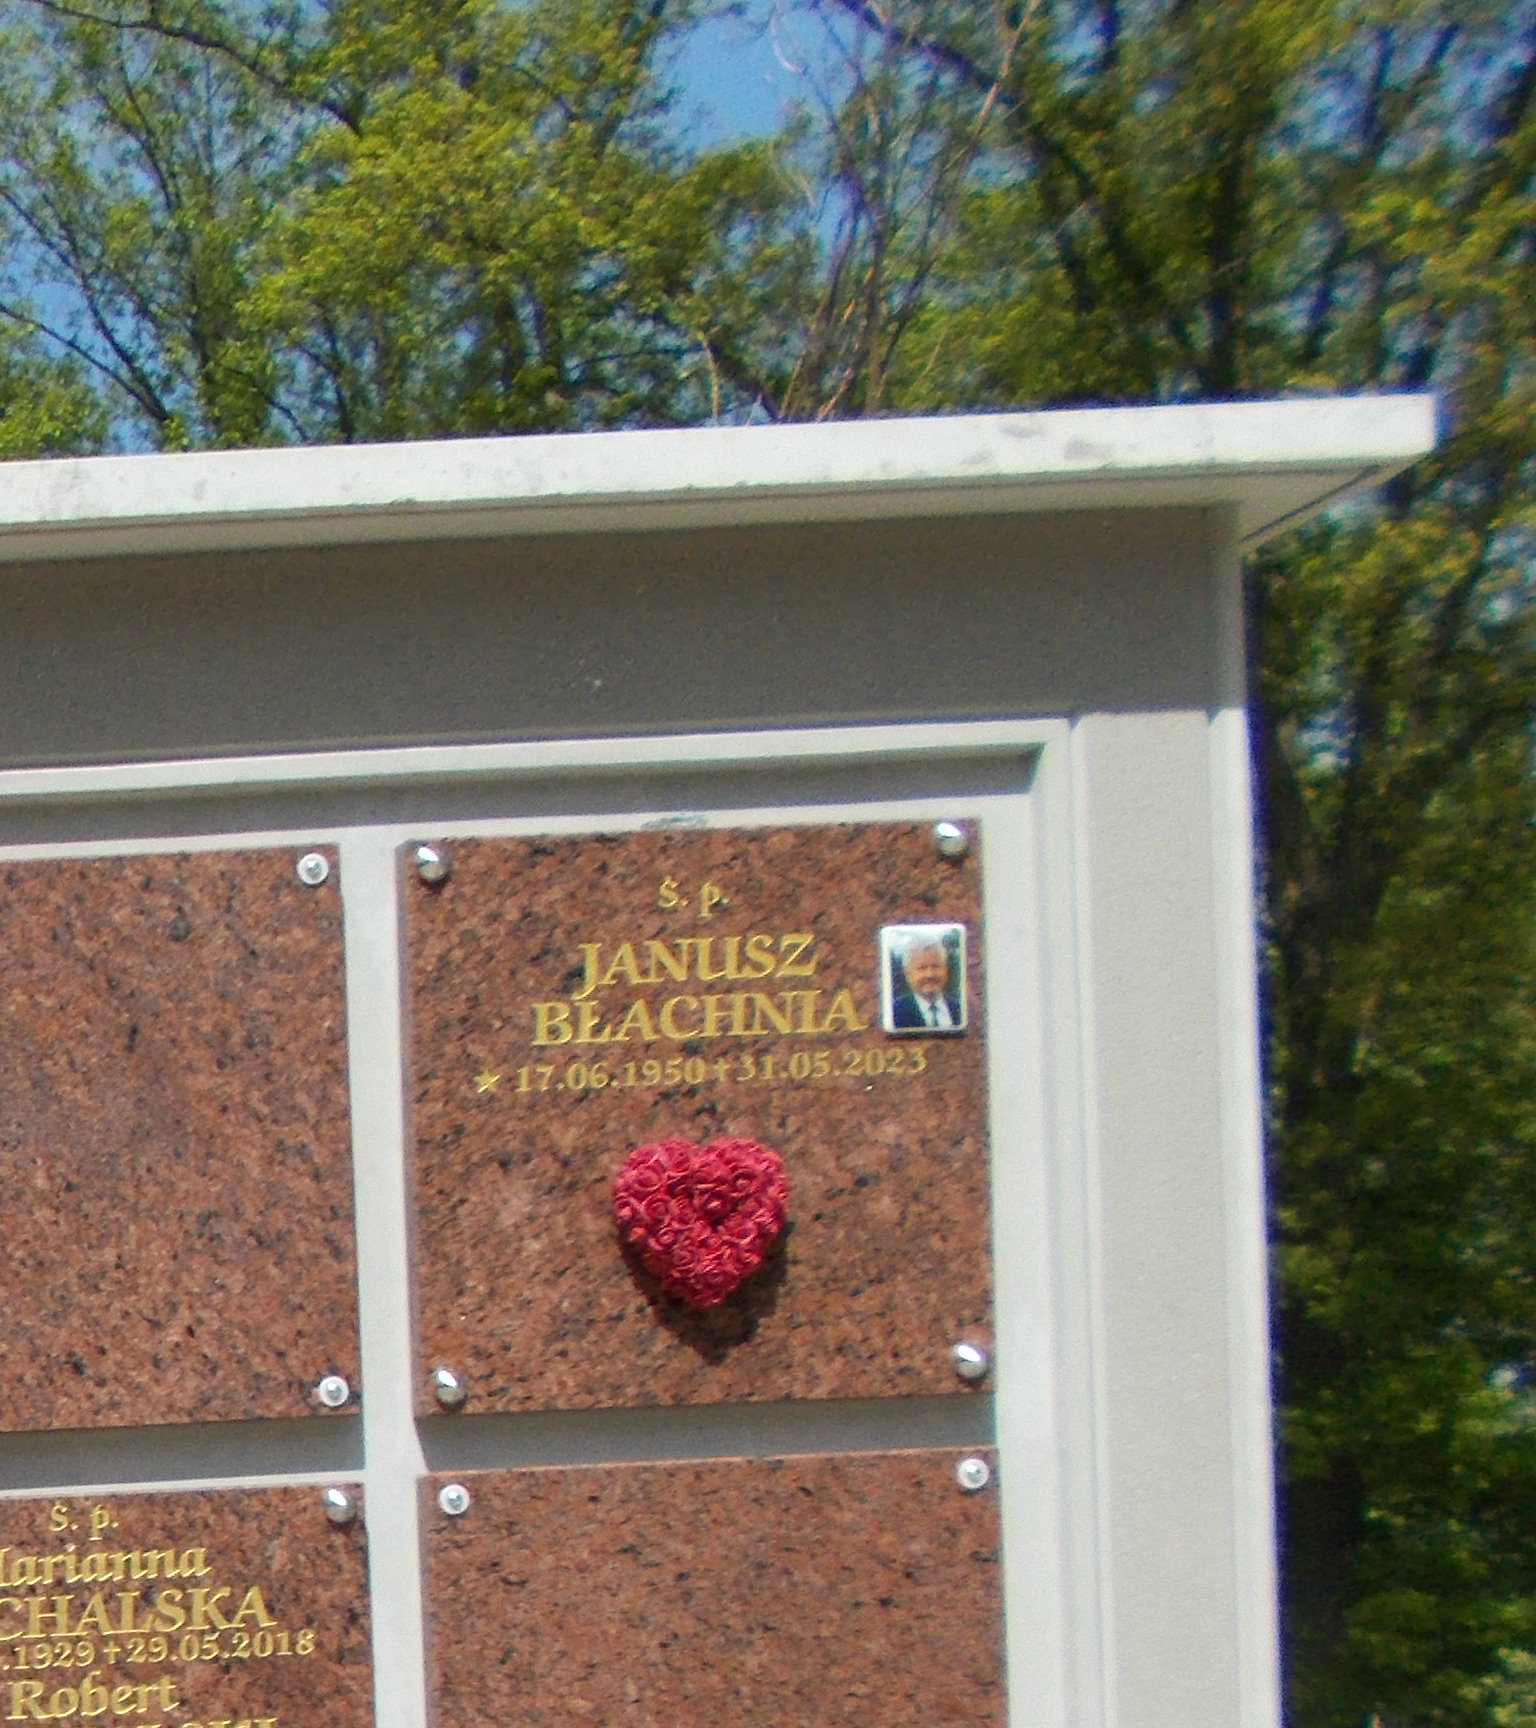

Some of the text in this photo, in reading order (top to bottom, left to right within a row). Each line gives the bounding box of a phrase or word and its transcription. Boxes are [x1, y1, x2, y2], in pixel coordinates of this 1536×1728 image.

[573, 932, 819, 999] JANUSZ
[531, 988, 868, 1046] BŁACHNIA
[516, 1047, 927, 1093] 17.06.1950 31.05.2023
[126, 1629, 316, 1664] 29.05.2018
[6, 1670, 180, 1721] Robert
